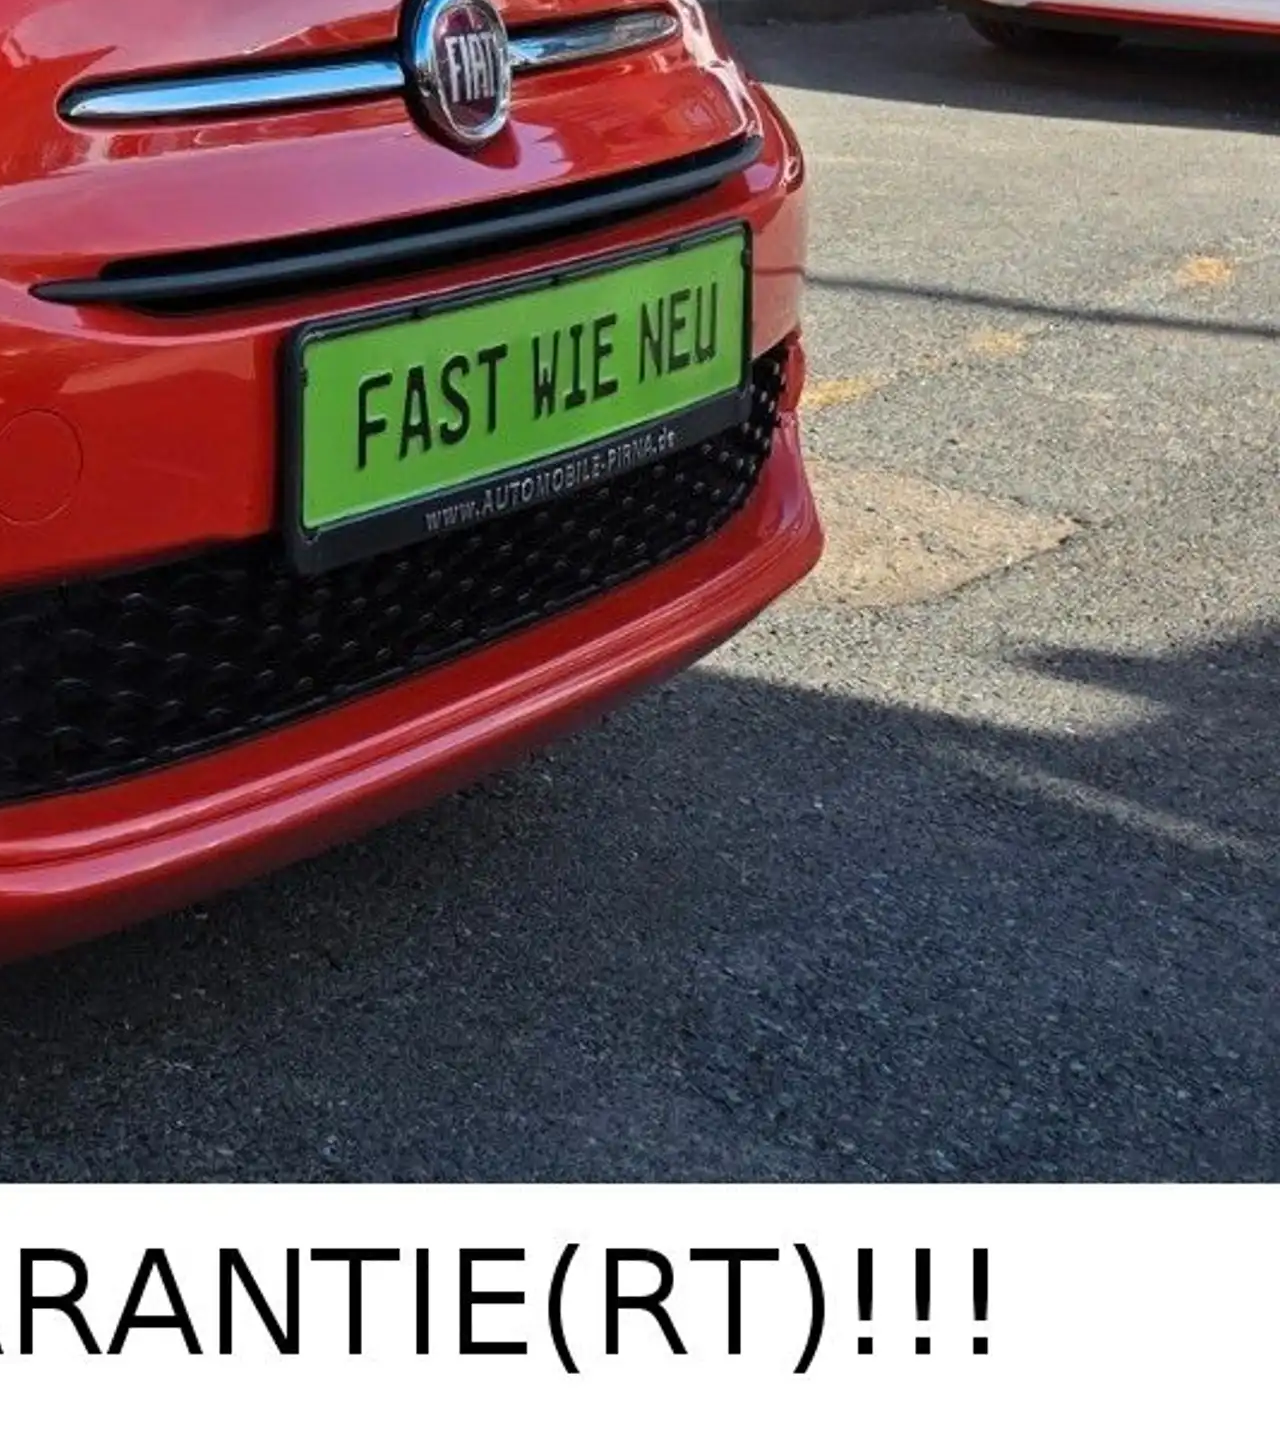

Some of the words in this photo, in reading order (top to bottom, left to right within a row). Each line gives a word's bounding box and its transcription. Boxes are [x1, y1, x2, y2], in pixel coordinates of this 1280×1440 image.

[444, 32, 498, 103] FIAT
[356, 343, 508, 471] FAST
[532, 313, 618, 420] WIE
[640, 282, 718, 384] NEU
